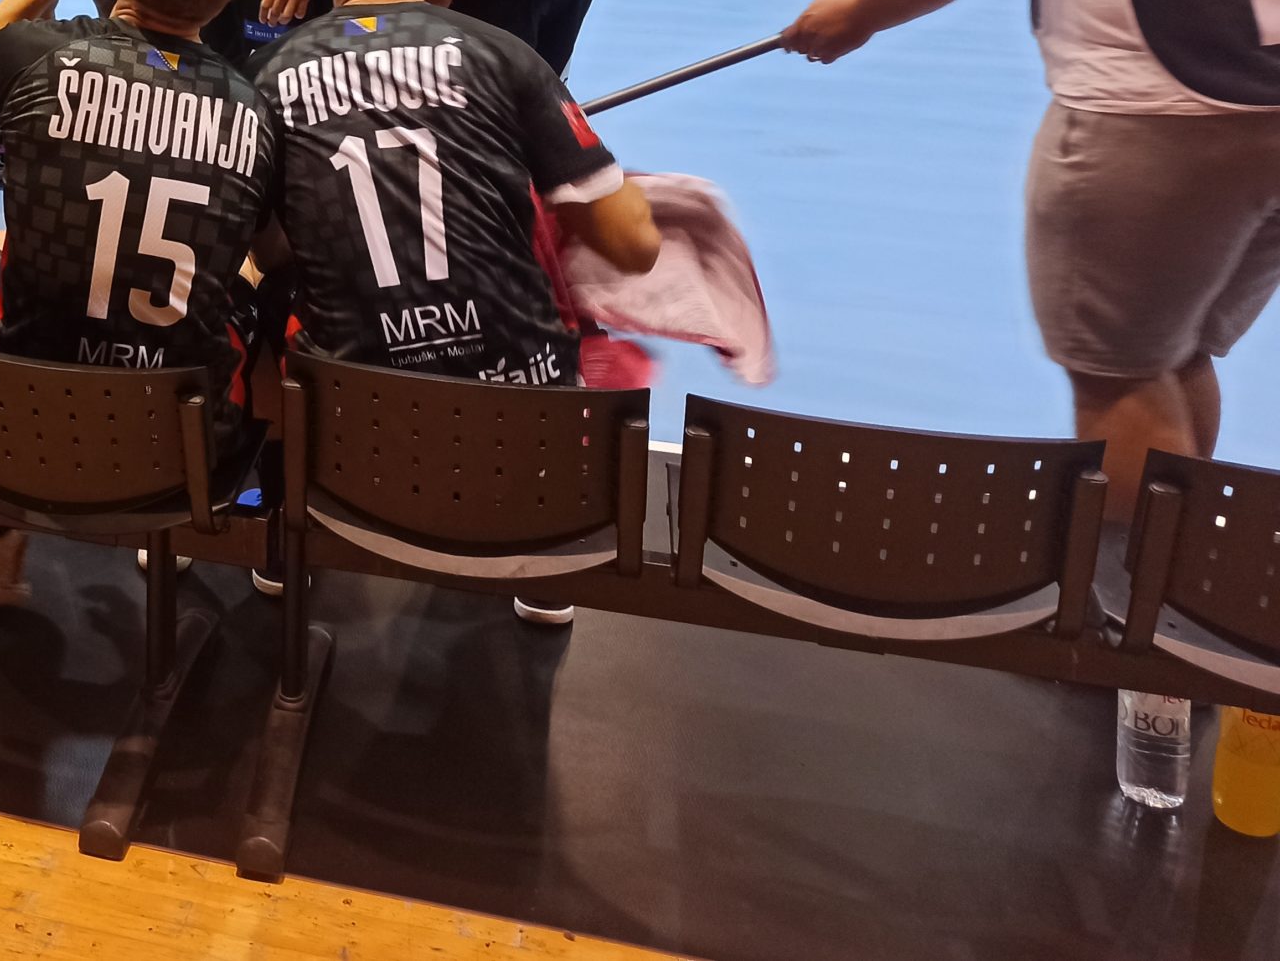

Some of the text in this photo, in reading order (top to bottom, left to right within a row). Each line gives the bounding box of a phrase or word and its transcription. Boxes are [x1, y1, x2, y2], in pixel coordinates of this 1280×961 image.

[48, 57, 259, 177] ŠARAVANJA
[278, 36, 469, 128] PAVLOVIĆ
[85, 170, 211, 327] 15
[329, 125, 450, 288] 17
[77, 337, 165, 370] MRM
[380, 299, 481, 344] MRM
